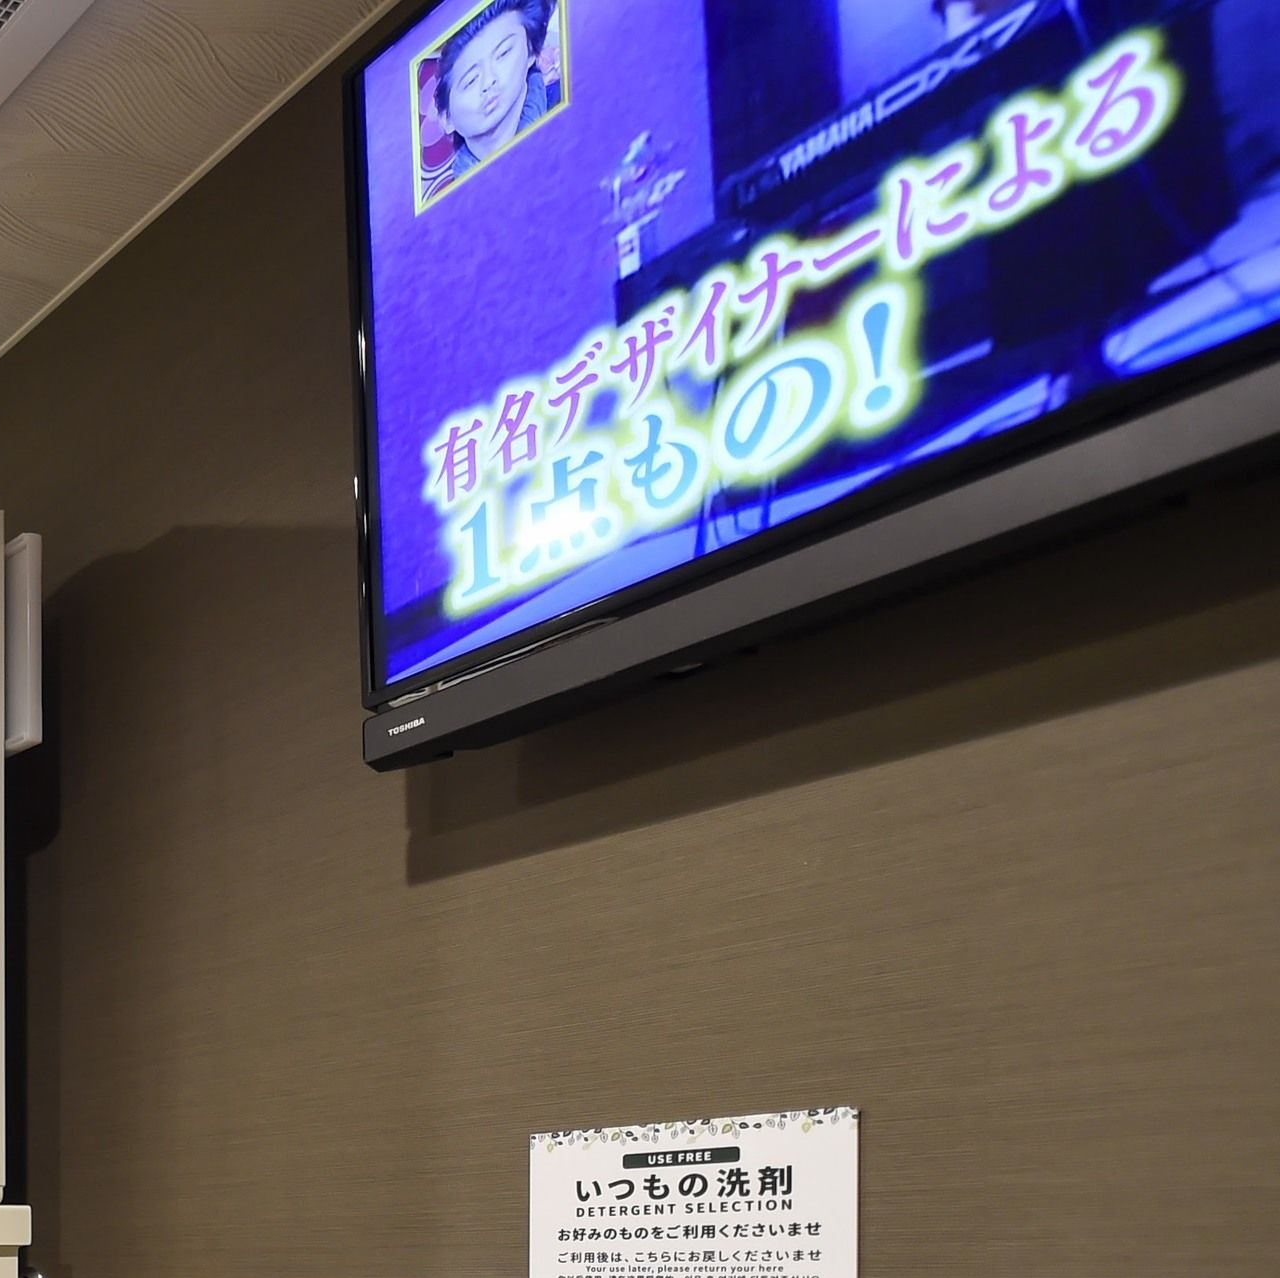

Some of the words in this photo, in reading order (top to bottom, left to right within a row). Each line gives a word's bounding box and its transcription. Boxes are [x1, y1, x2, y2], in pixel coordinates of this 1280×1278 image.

[433, 50, 1158, 504] 有名デザイナーによる
[387, 716, 426, 737] TOSHIBA
[647, 1153, 673, 1165] USE
[677, 1150, 712, 1163] FREE
[575, 1164, 793, 1203] いつもの洗剤
[576, 1202, 677, 1218] DETERGENT
[684, 1198, 793, 1214] SELECTION
[557, 1221, 823, 1243] お好みのものをご利用くださいませ
[557, 1249, 823, 1264] ご利用後は、こちらにお戻しくださいませ
[585, 1265, 607, 1273] Your
[628, 1264, 655, 1274] later,
[657, 1264, 690, 1274] please
[693, 1265, 727, 1273] return
[730, 1265, 756, 1274] your
[758, 1264, 784, 1273] here
